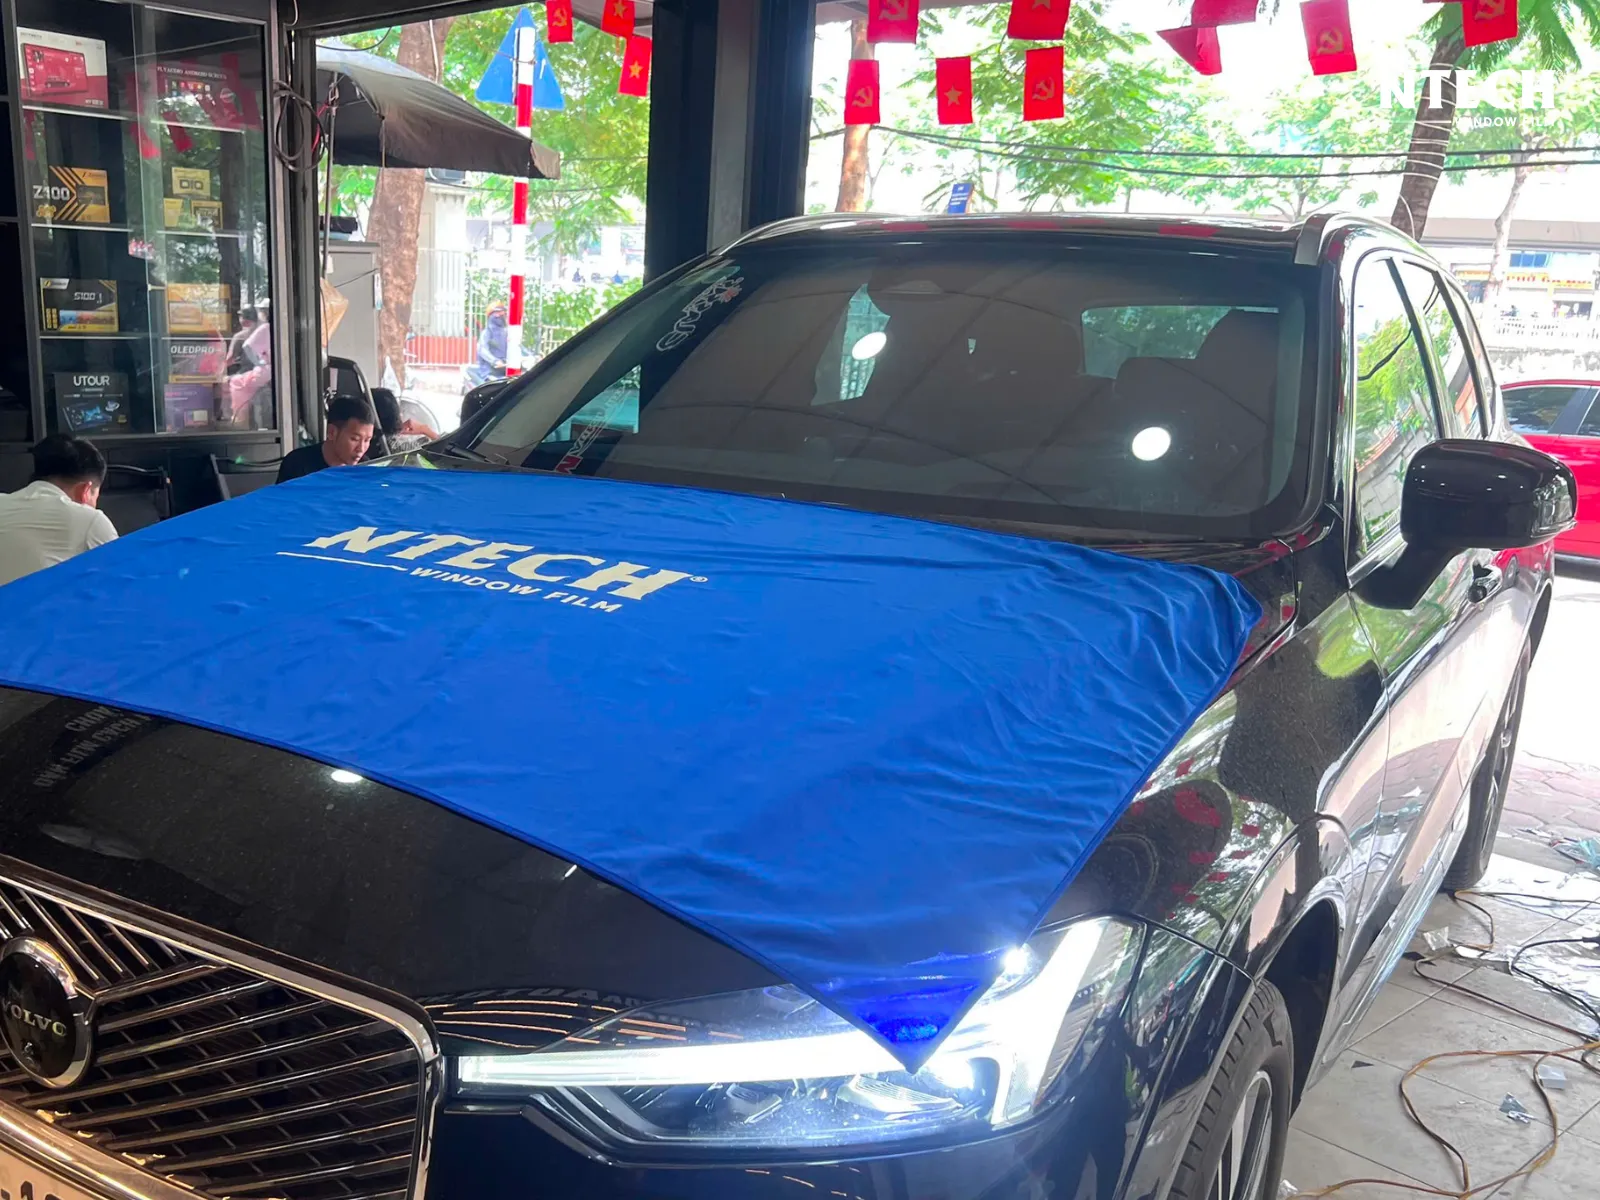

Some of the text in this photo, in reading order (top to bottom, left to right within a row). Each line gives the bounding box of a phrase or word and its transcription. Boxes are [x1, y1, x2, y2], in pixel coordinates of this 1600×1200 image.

[32, 185, 71, 201] Z100
[73, 291, 96, 301] S100
[170, 345, 215, 355] OLEDPRO
[73, 375, 110, 387] UTOUR
[302, 526, 694, 601] NTECH
[409, 566, 623, 613] WINDOW FILM
[1, 997, 68, 1037] VOLVO
